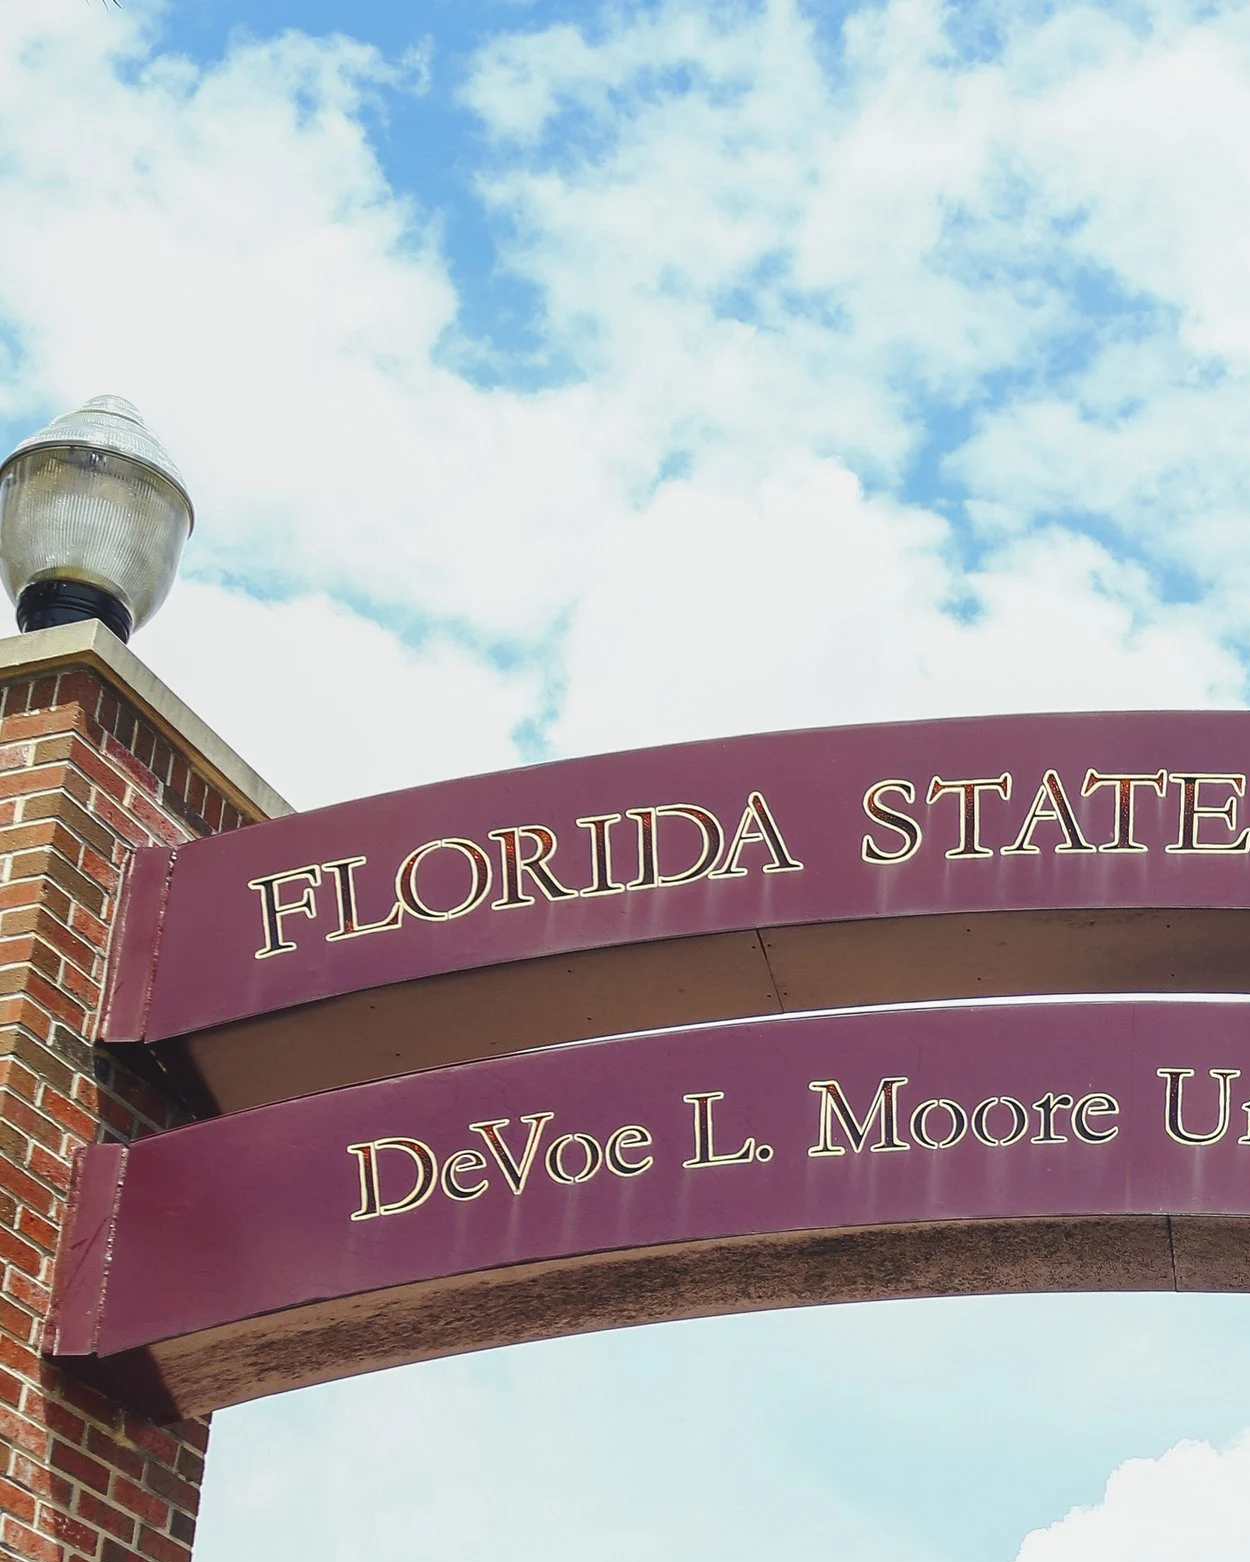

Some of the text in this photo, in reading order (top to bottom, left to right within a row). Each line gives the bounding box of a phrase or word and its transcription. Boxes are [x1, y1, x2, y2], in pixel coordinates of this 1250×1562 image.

[249, 791, 803, 959] FLORIDA
[347, 1112, 653, 1221] DeVoe
[682, 1091, 774, 1168] L.
[808, 1076, 1119, 1157] Moore
